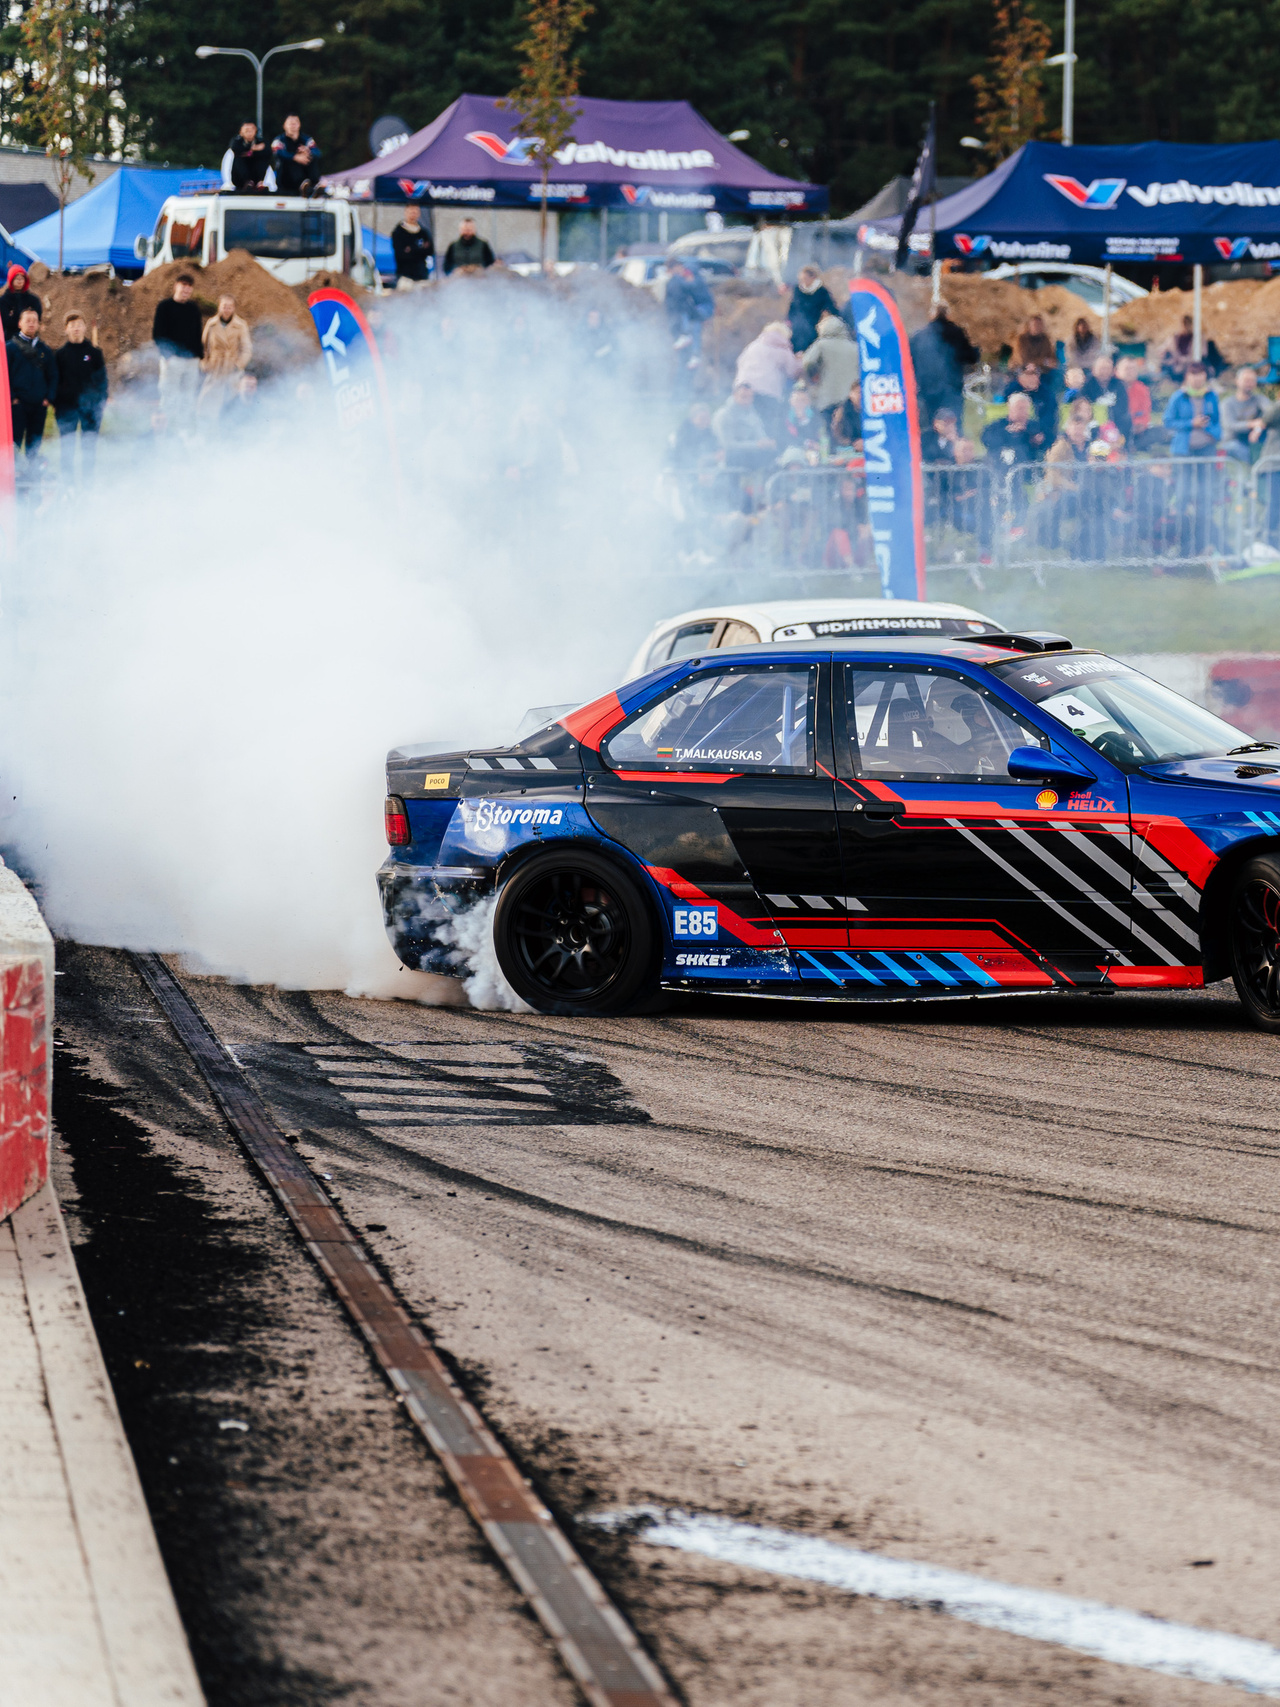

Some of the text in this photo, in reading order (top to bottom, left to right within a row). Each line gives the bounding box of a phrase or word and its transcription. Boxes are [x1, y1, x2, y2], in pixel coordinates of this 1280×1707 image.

[552, 140, 716, 171] Valvoline
[988, 242, 1071, 259] Valvoline
[1067, 705, 1085, 716] 4
[675, 748, 763, 761] T.MALKAUSKAS
[429, 777, 446, 785] POCO
[1069, 791, 1092, 799] Shell
[1067, 796, 1116, 811] HELIX
[476, 799, 562, 832] Storoma
[674, 910, 717, 935] E85
[675, 953, 731, 967] SHKET
